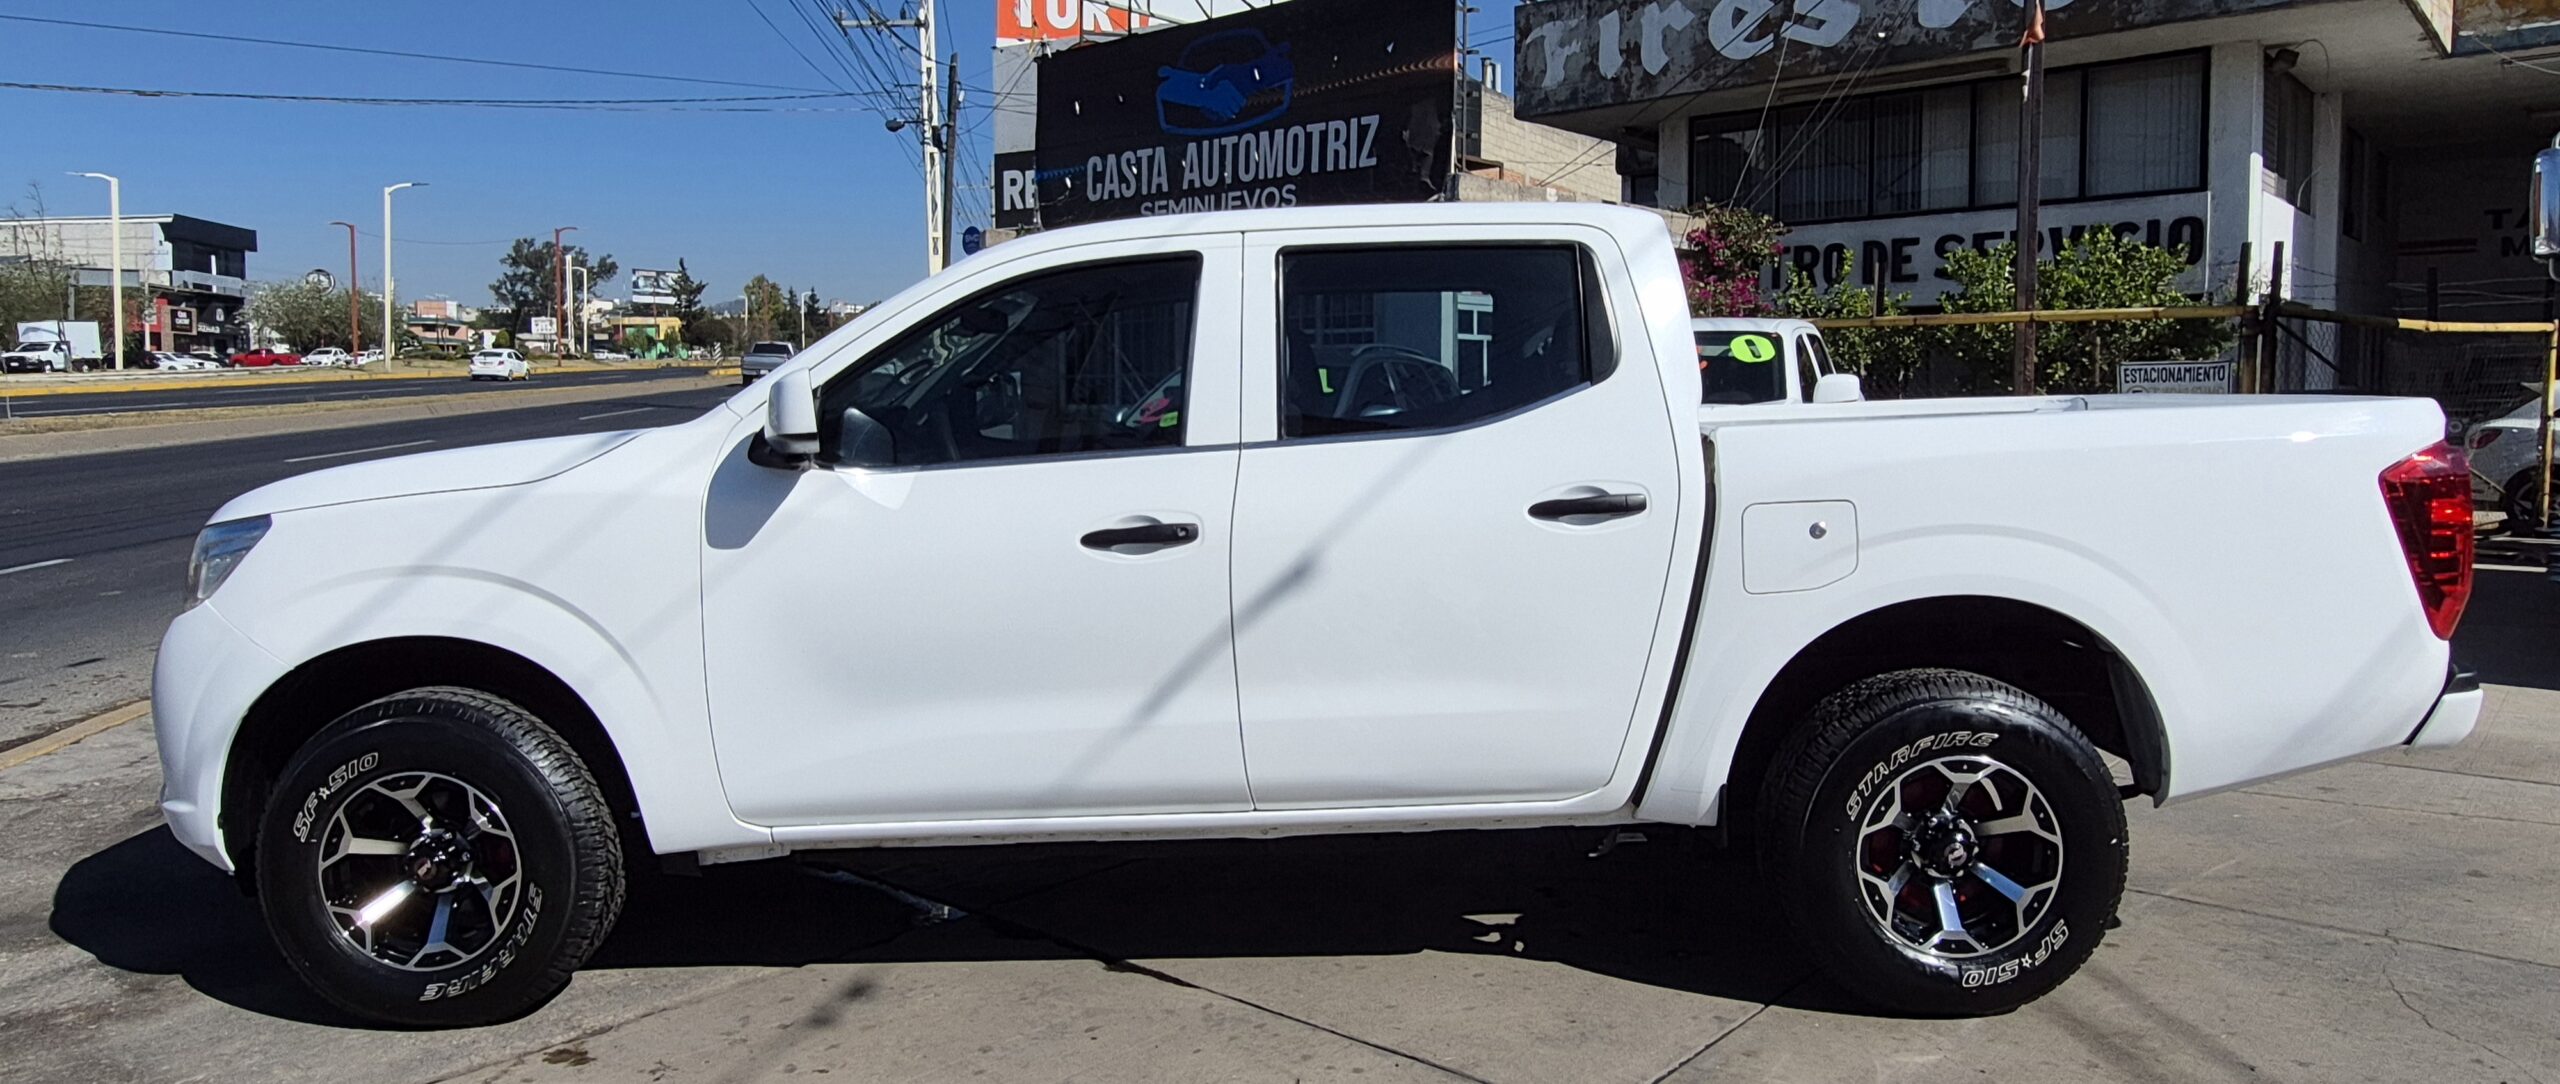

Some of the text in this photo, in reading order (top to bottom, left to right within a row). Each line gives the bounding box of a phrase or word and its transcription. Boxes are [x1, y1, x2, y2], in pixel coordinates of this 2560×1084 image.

[1086, 114, 1380, 201] CASTA AUTOMOTRIZ
[1140, 184, 1297, 216] SEMINUEVOS
[1862, 237, 1921, 283] DE
[2123, 364, 2226, 384] ESTACIONAMIENTO
[1846, 731, 2000, 821] STARFIRE
[419, 882, 544, 1002] STARFIRE
